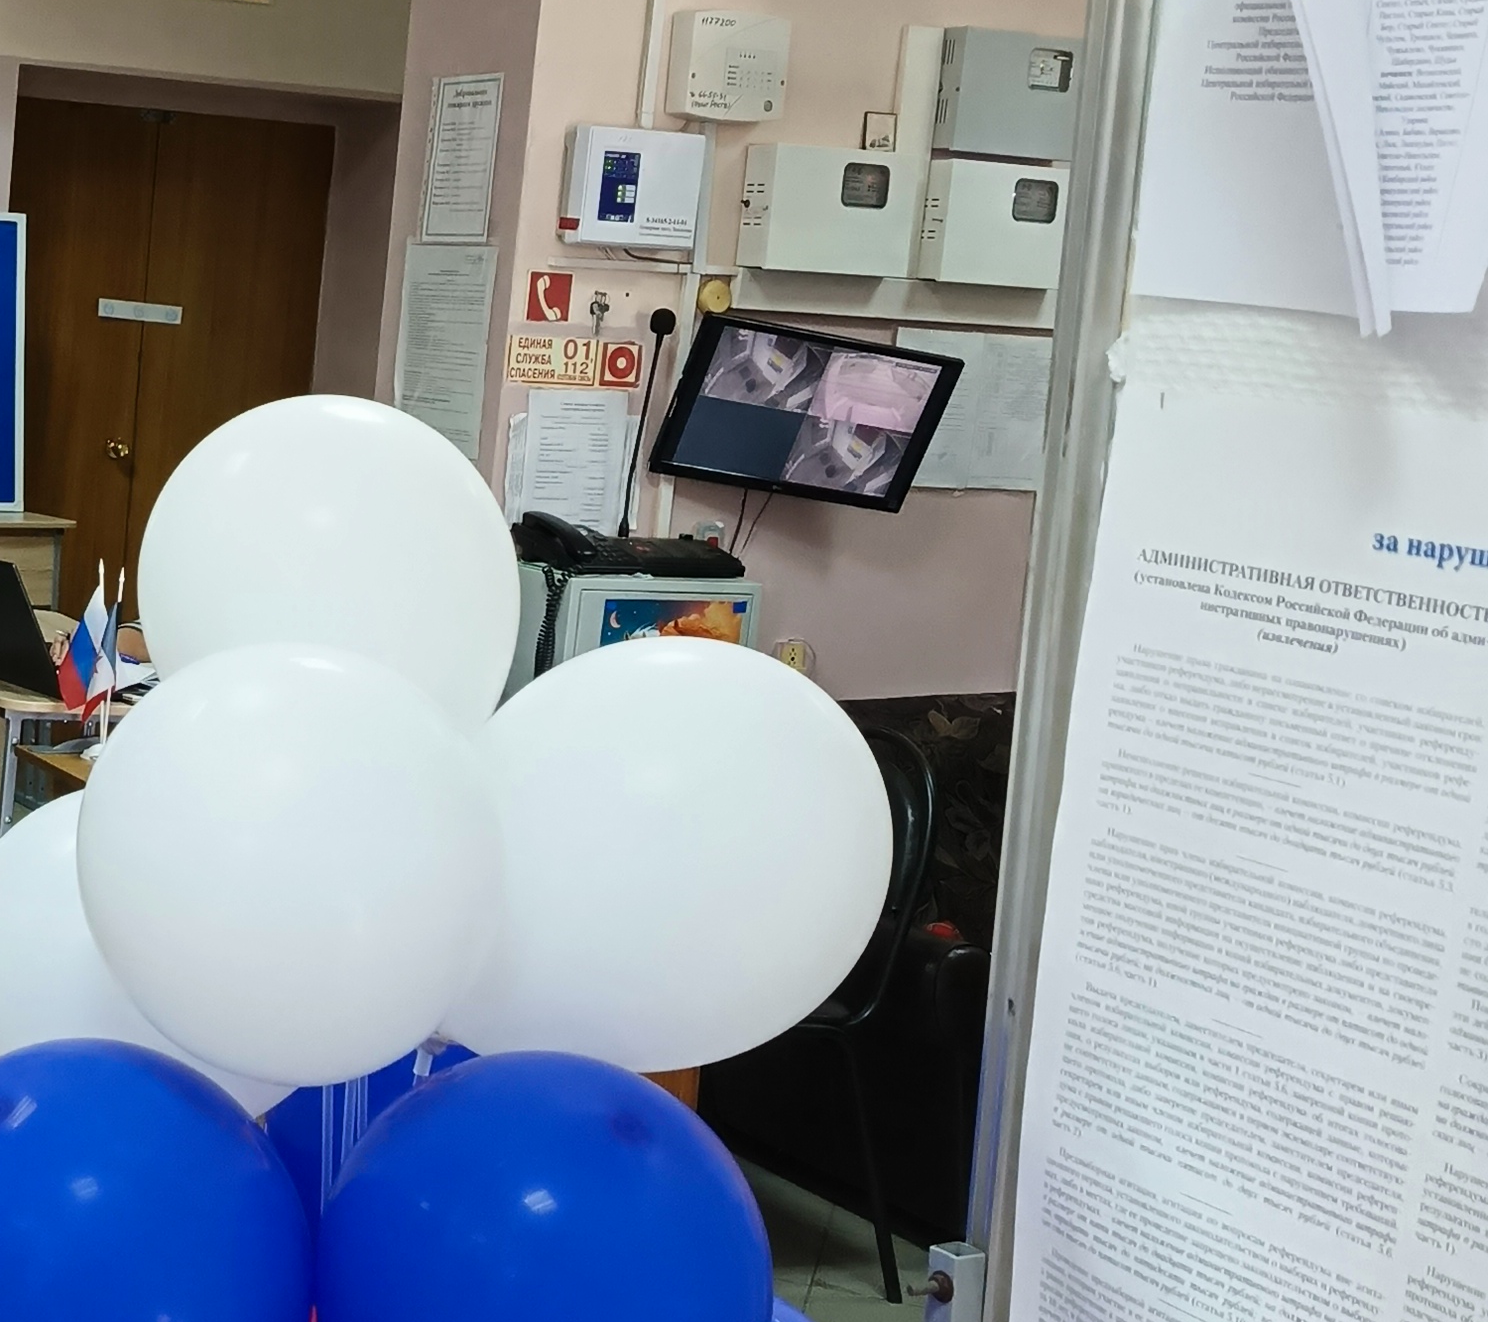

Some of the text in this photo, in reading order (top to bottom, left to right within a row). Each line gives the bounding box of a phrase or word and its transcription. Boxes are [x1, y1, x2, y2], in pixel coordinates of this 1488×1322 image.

[518, 337, 553, 350] ЕДИНАЯ
[516, 353, 552, 365] СЛУЖБА
[510, 367, 556, 379] СПАСЕНИЯ
[564, 361, 589, 375] 112
[1372, 533, 1398, 553] за
[1137, 548, 1315, 592] АДМИНИСТРАТИВНАЯ
[1134, 570, 1210, 597] (установлена
[1213, 584, 1273, 607] Кодексом
[1275, 596, 1351, 620] Российской
[1352, 609, 1428, 637] Федерации
[1431, 625, 1449, 639] об
[1200, 601, 1408, 652] нистративных правонарушениях)
